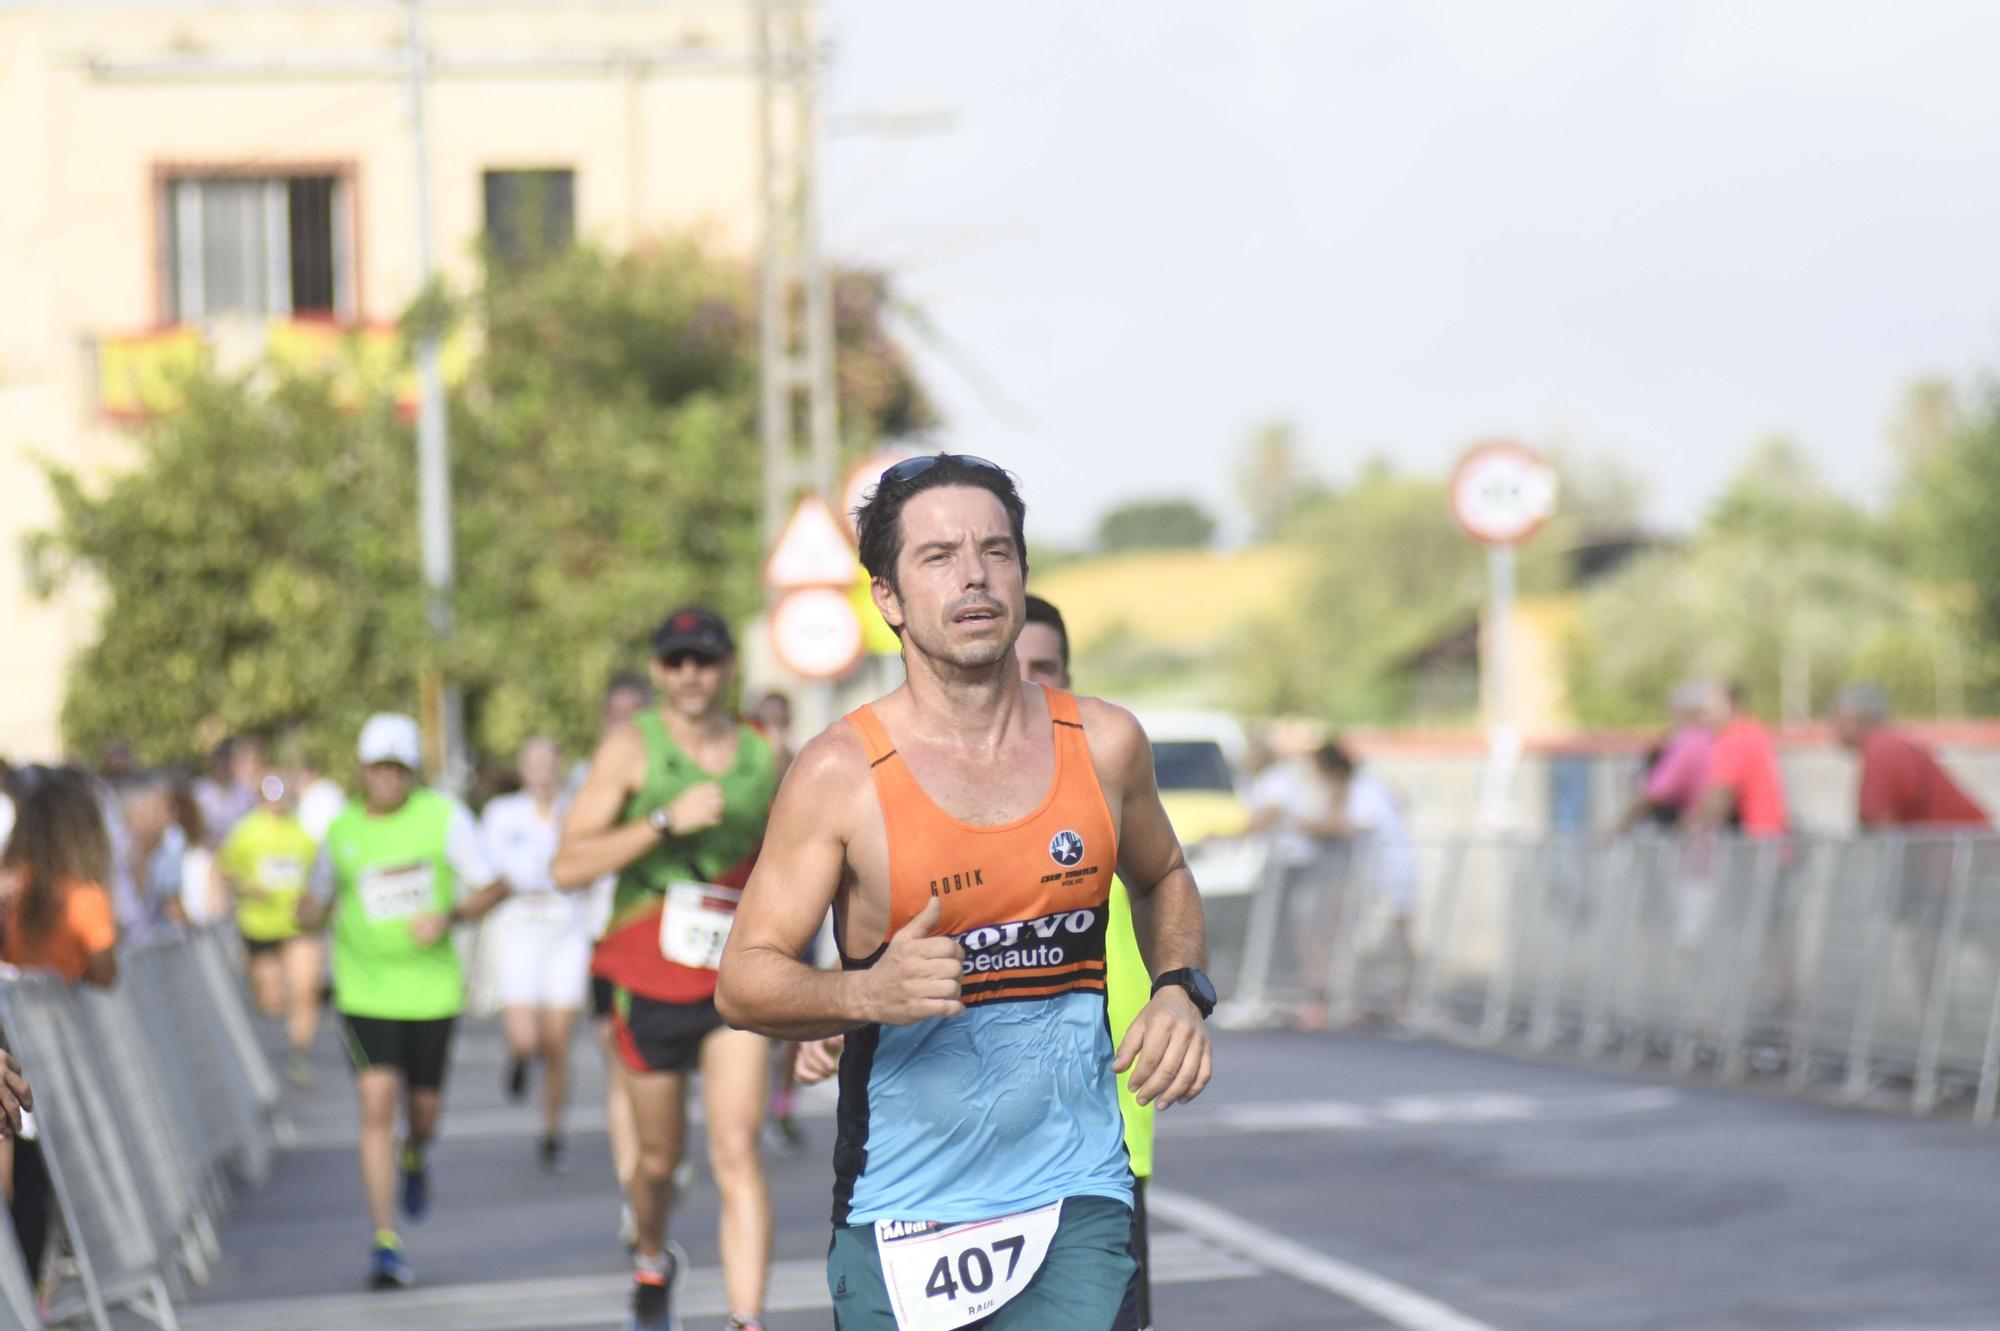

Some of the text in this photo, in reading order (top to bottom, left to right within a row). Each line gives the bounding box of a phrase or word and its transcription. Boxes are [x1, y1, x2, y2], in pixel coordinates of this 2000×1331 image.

[930, 868, 984, 897] GOBIK
[925, 1234, 1025, 1301] 407
[968, 1299, 995, 1316] RAUL
